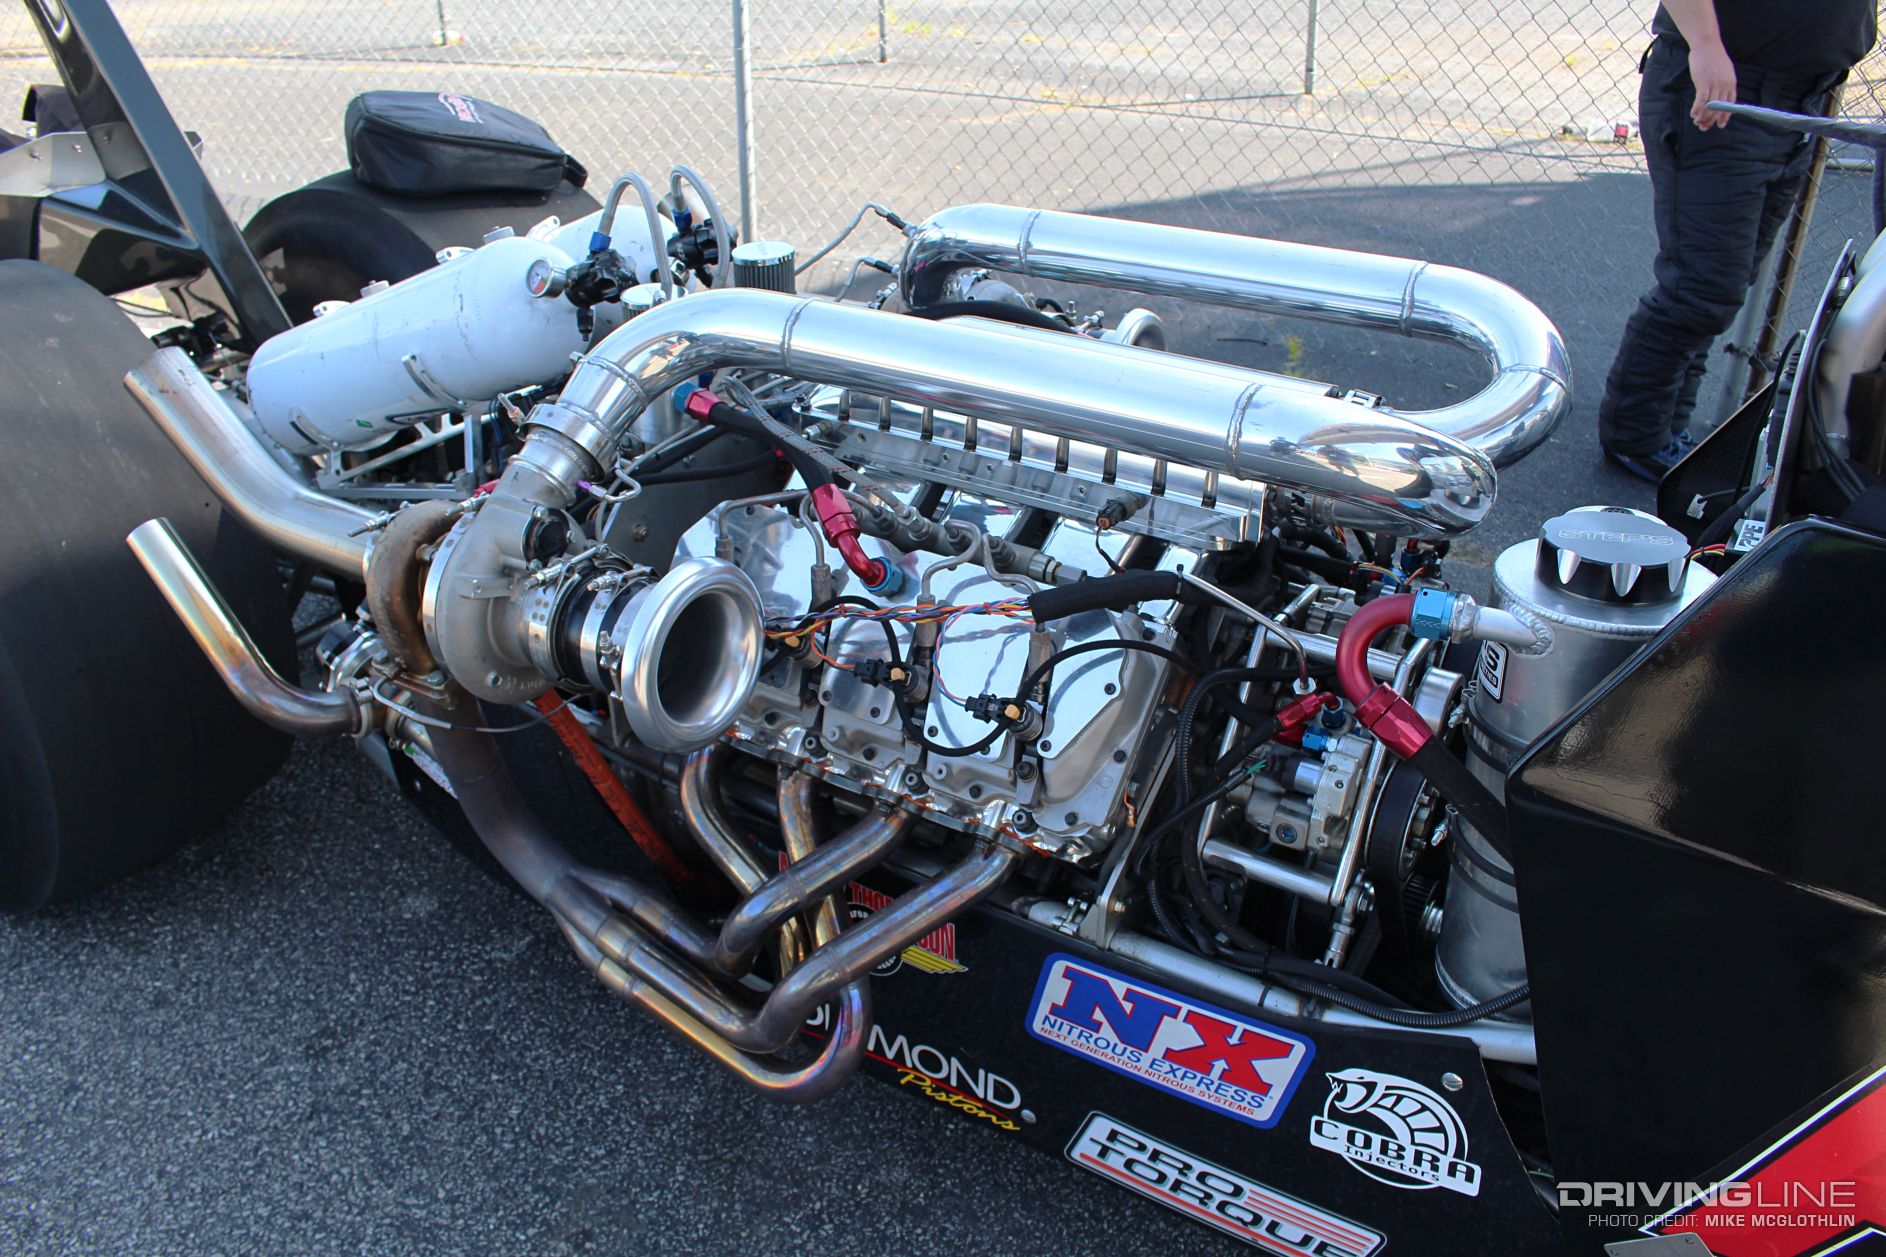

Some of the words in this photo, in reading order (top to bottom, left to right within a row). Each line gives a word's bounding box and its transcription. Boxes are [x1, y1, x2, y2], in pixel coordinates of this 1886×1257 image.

[1041, 1014, 1144, 1064] NITROUS
[1149, 1058, 1264, 1109] EXPRESS
[1048, 965, 1296, 1098] NX
[896, 1067, 1021, 1131] Pistons
[1040, 1026, 1068, 1042] NEXT
[1070, 1038, 1142, 1073] GENERATION
[1144, 1068, 1196, 1094] NITROUS
[1198, 1090, 1255, 1115] SYSTEMS
[1105, 1128, 1244, 1200] PRO
[1314, 1119, 1475, 1184] COBRA
[1344, 1144, 1440, 1182] Injectors
